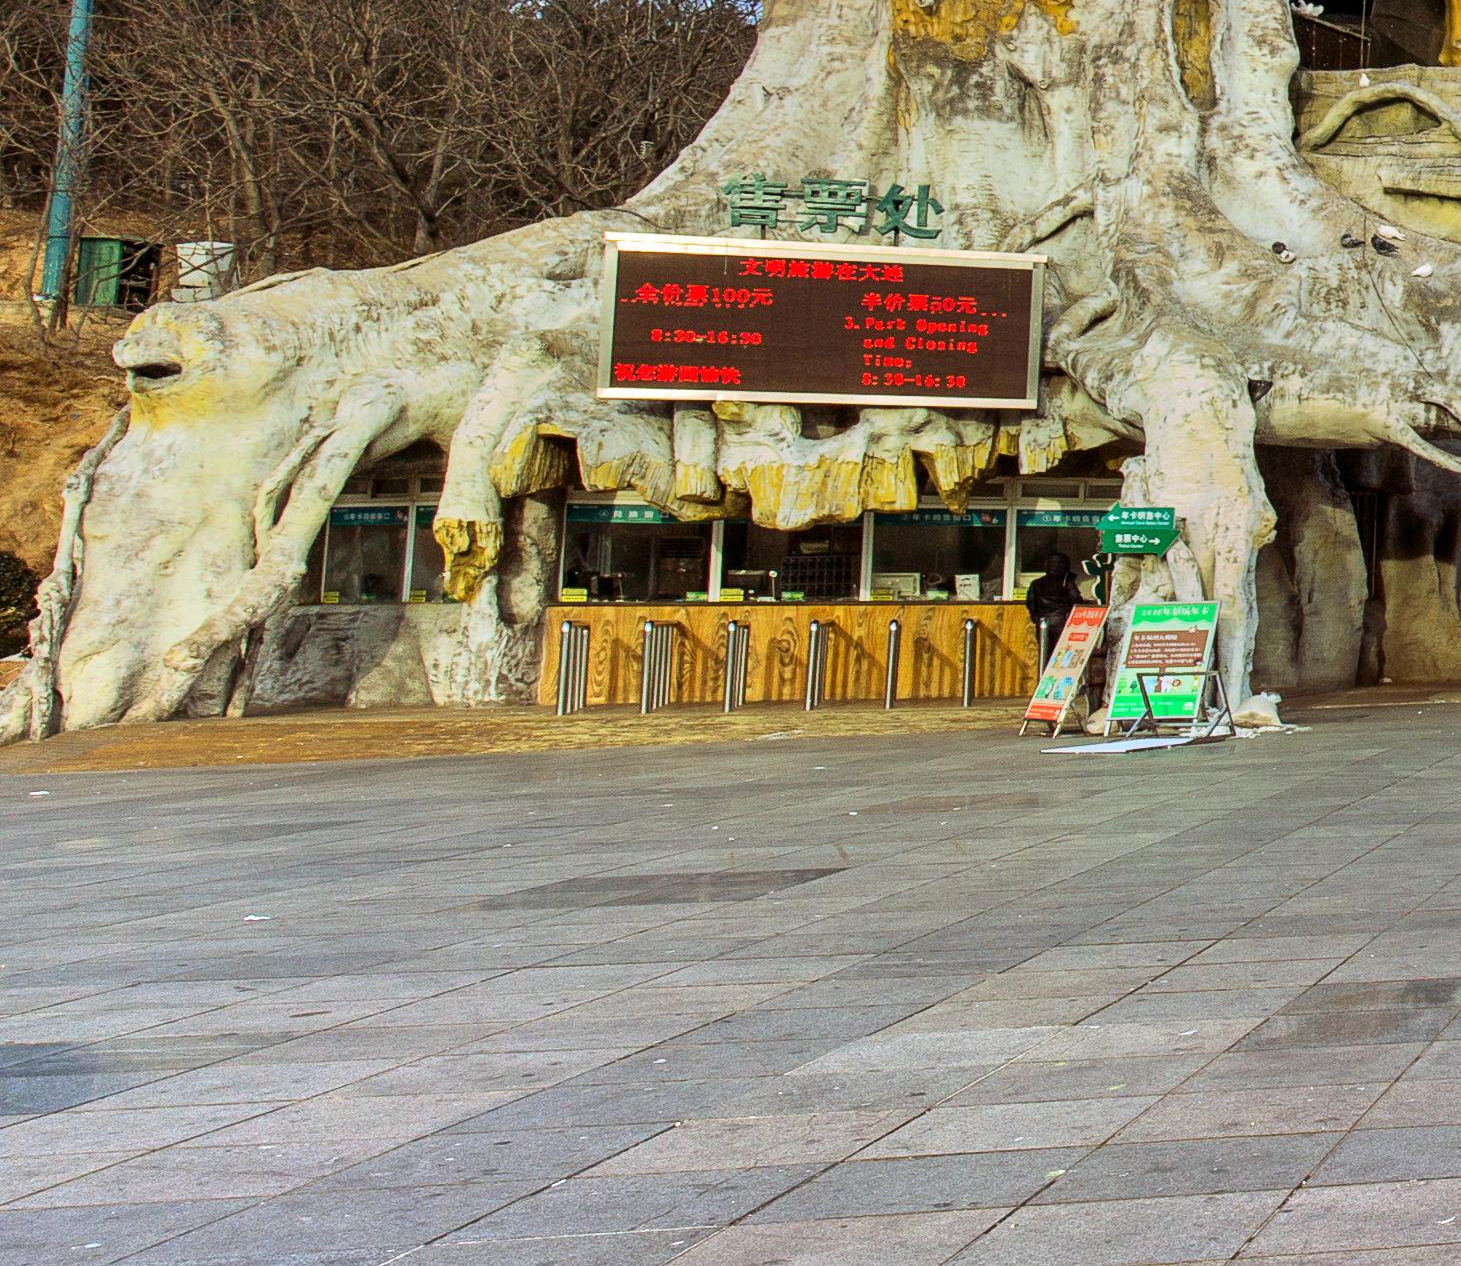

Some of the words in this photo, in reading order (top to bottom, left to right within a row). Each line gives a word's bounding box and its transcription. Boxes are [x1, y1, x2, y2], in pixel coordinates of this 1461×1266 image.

[721, 172, 945, 239] 售票处
[916, 318, 989, 336] Opening
[904, 336, 978, 354] Closing
